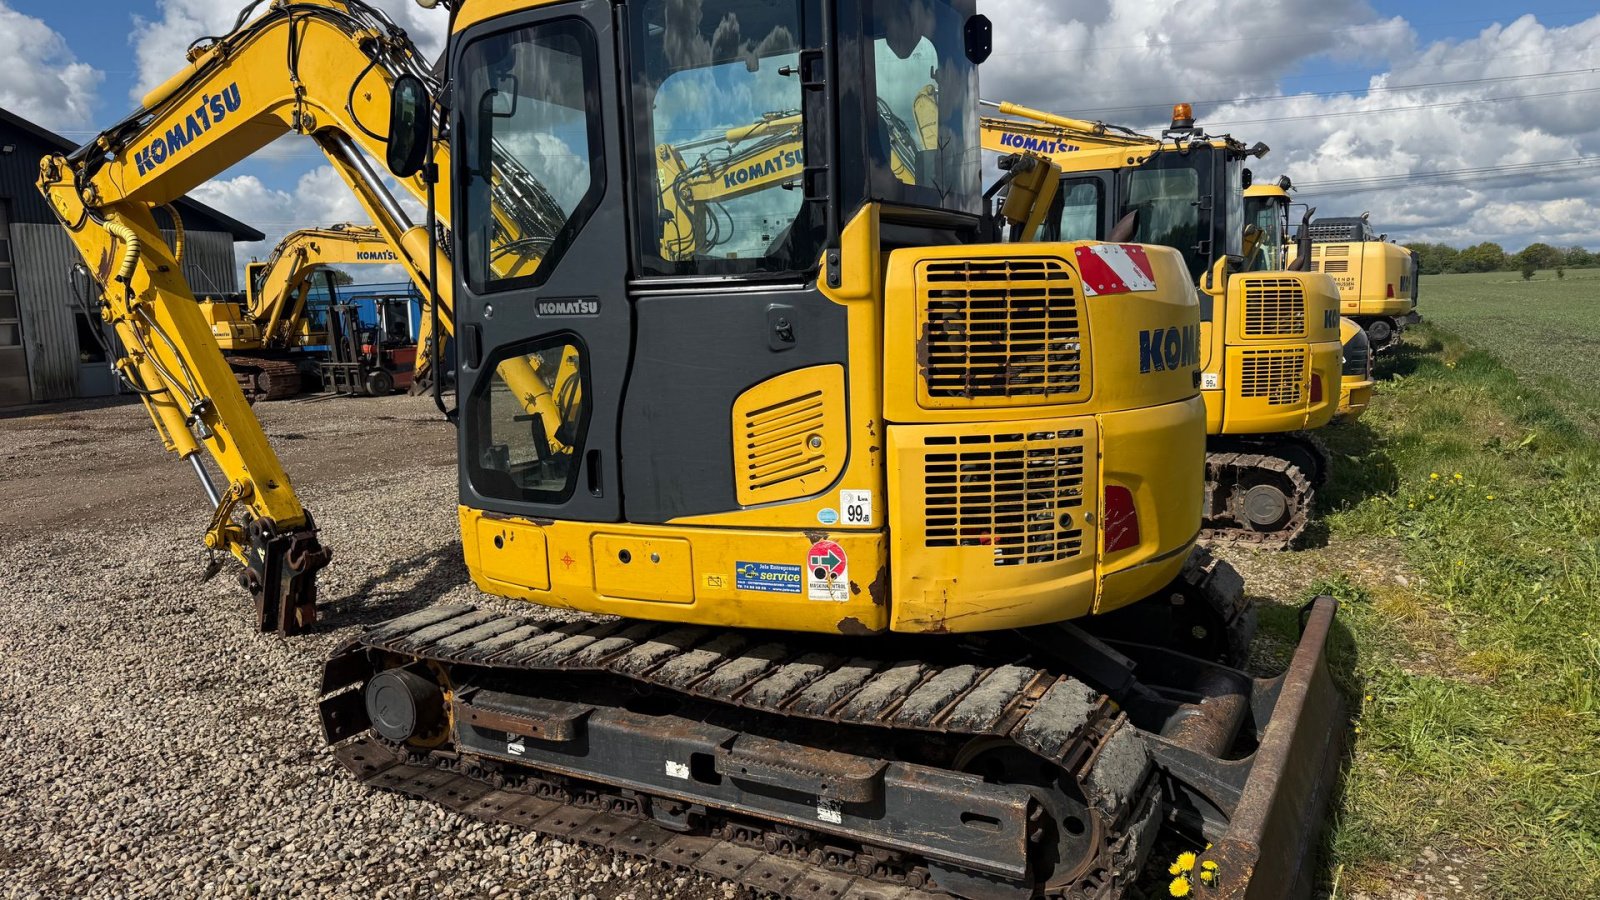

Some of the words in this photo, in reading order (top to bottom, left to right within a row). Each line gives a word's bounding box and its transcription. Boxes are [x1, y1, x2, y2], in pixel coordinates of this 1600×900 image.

[134, 82, 242, 177] KOMATSU
[539, 299, 598, 315] KOMATSU
[848, 504, 863, 522] 99
[863, 514, 870, 522] dB
[760, 571, 800, 582] service
